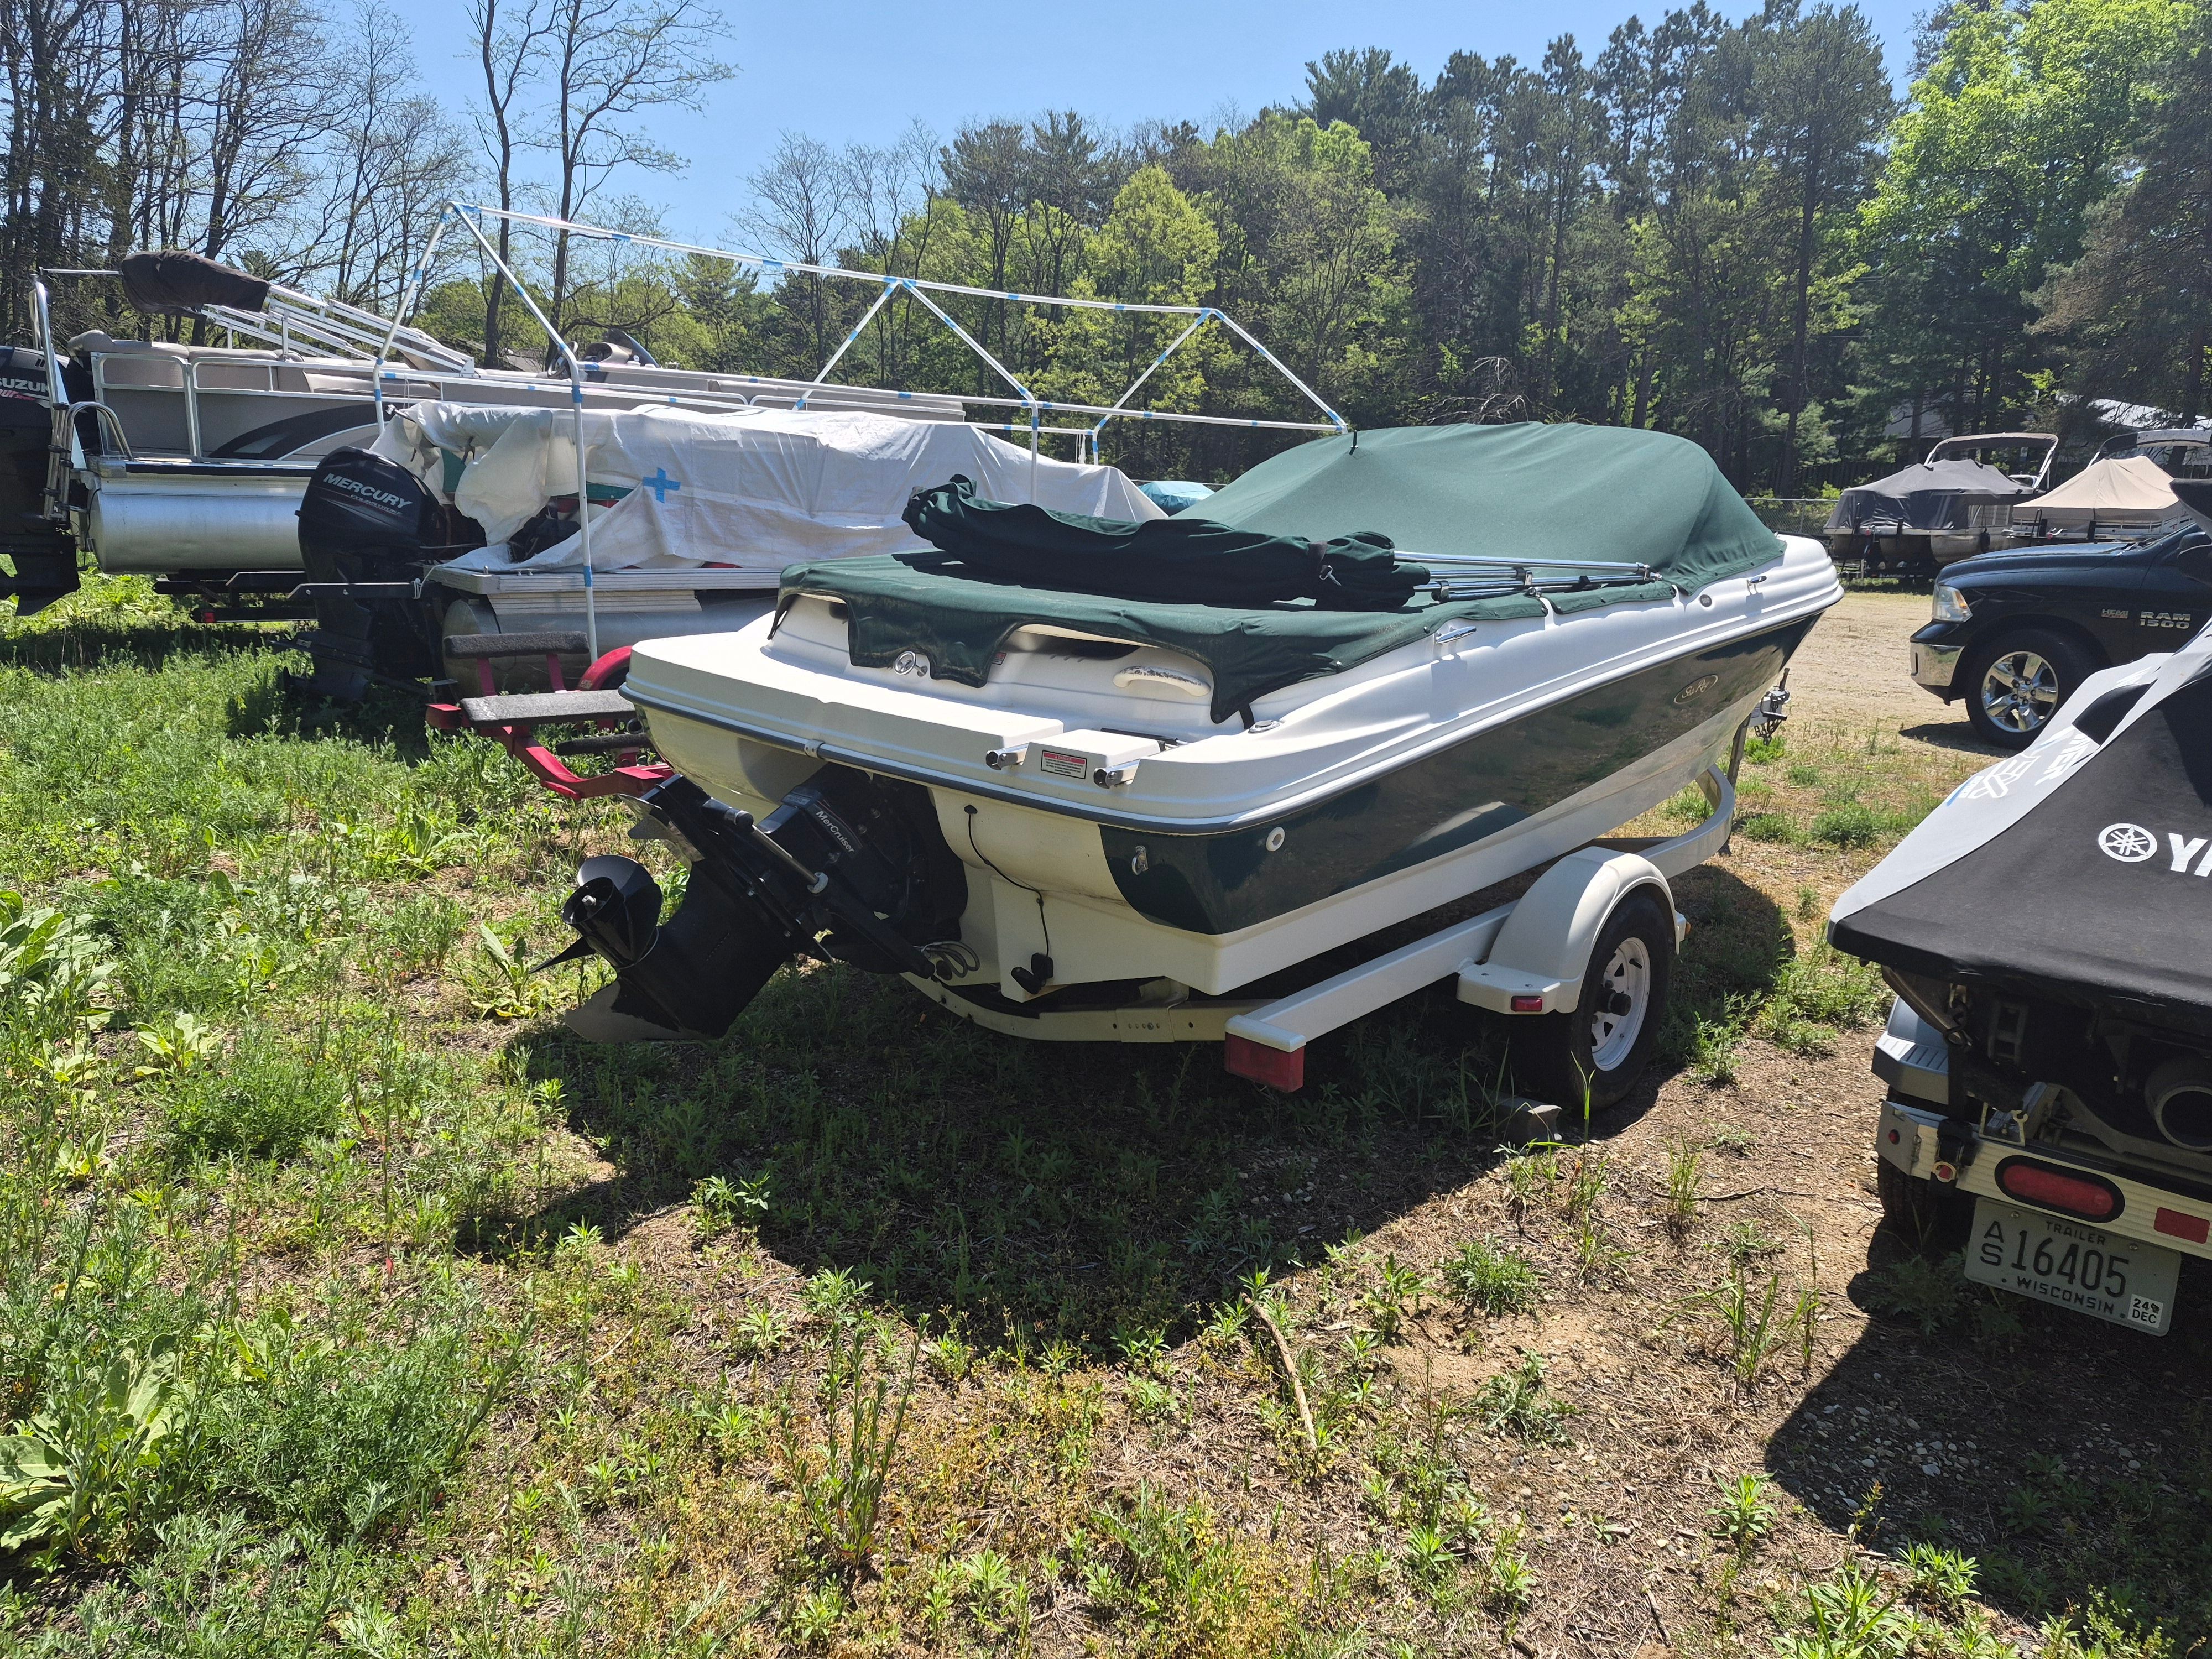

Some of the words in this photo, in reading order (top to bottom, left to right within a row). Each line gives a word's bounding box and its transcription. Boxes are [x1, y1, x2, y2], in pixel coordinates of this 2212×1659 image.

[323, 473, 413, 508] MERCURY
[2140, 611, 2191, 622] RAM
[2140, 619, 2190, 629] 1500
[816, 811, 855, 853] MerCruiser
[2046, 1220, 2106, 1245] TRAILER
[2011, 1230, 2129, 1297] 16405
[2017, 1275, 2114, 1314] WISCONSIN
[2132, 1309, 2157, 1323] DEC
